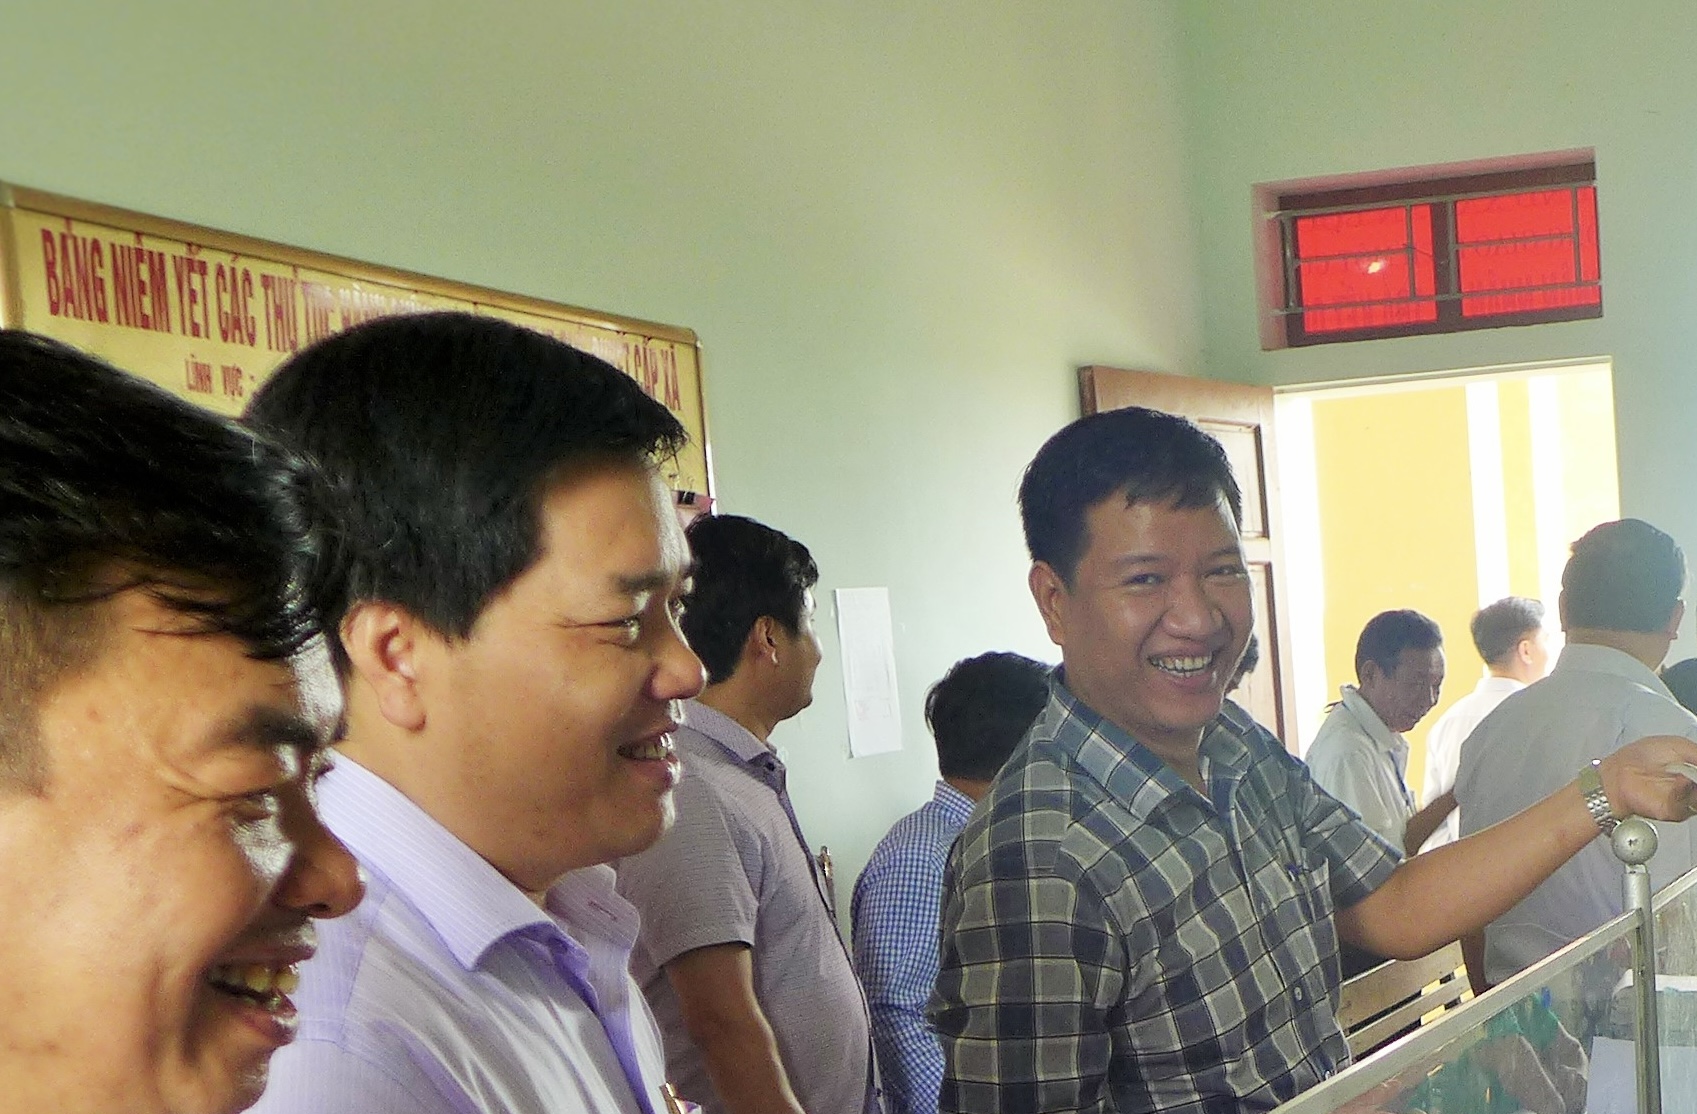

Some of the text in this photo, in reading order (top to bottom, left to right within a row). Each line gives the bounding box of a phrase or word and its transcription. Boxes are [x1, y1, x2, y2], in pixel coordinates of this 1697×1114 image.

[41, 217, 109, 323] BẢNG
[172, 242, 210, 340] YẾT
[215, 252, 256, 348] CÁC
